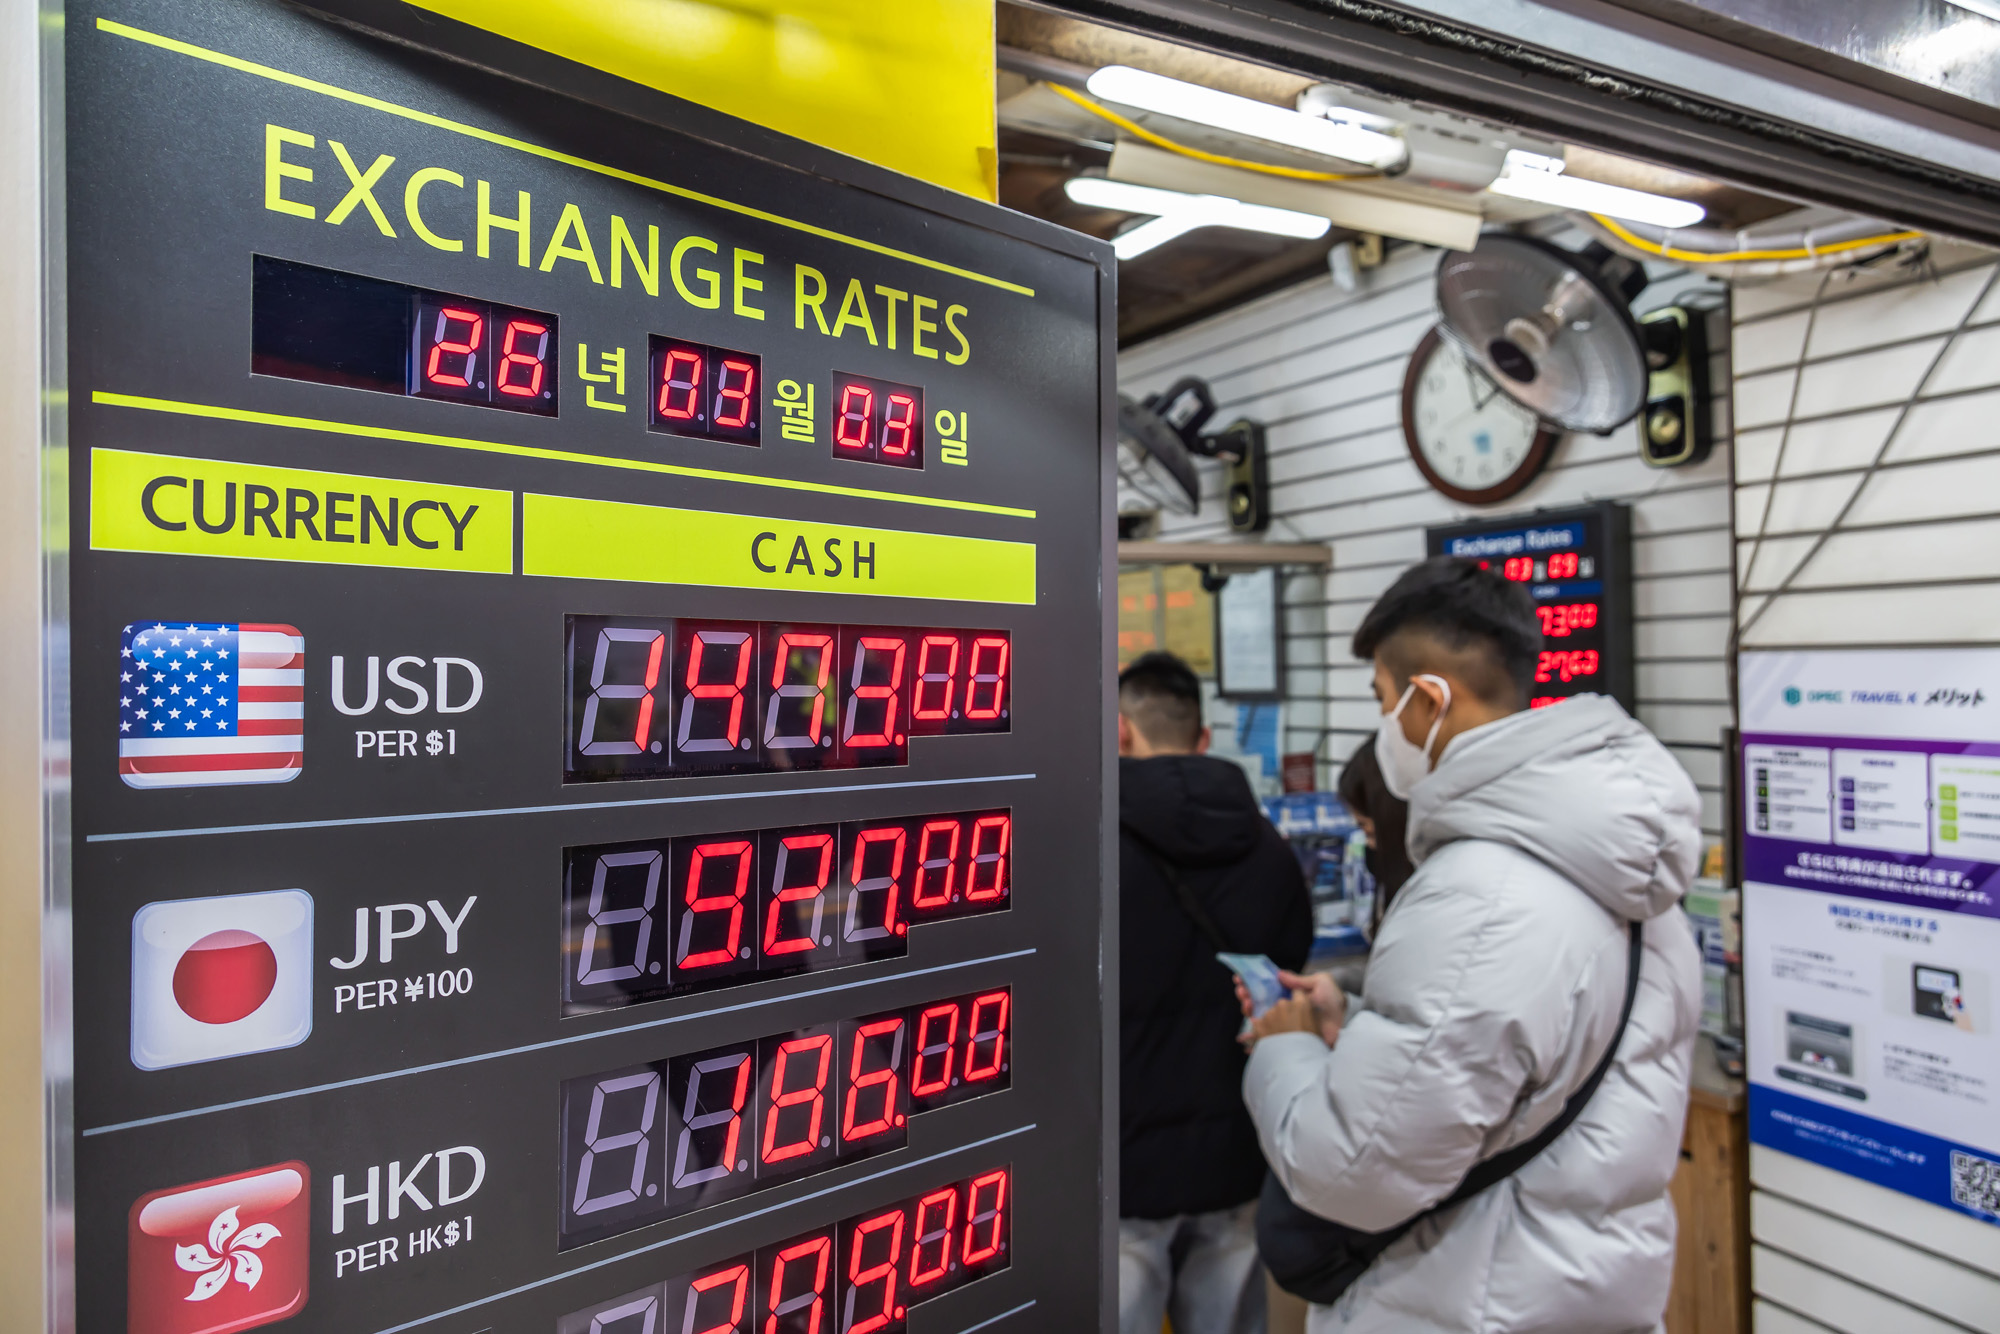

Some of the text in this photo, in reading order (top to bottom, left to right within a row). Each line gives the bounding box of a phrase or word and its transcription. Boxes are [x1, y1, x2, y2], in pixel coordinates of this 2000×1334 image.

[265, 123, 972, 366] EXCHANGE RATES
[426, 306, 968, 466] 26 년 03 월 03 일
[140, 475, 480, 552] CURRENCY
[750, 532, 878, 581] CASH
[331, 654, 484, 717] USD
[355, 729, 456, 759] PER $1
[329, 895, 478, 970] JPY
[334, 966, 474, 1014] PER ¥100
[331, 1145, 486, 1235] HKD
[334, 1214, 473, 1279] PER HK$1
